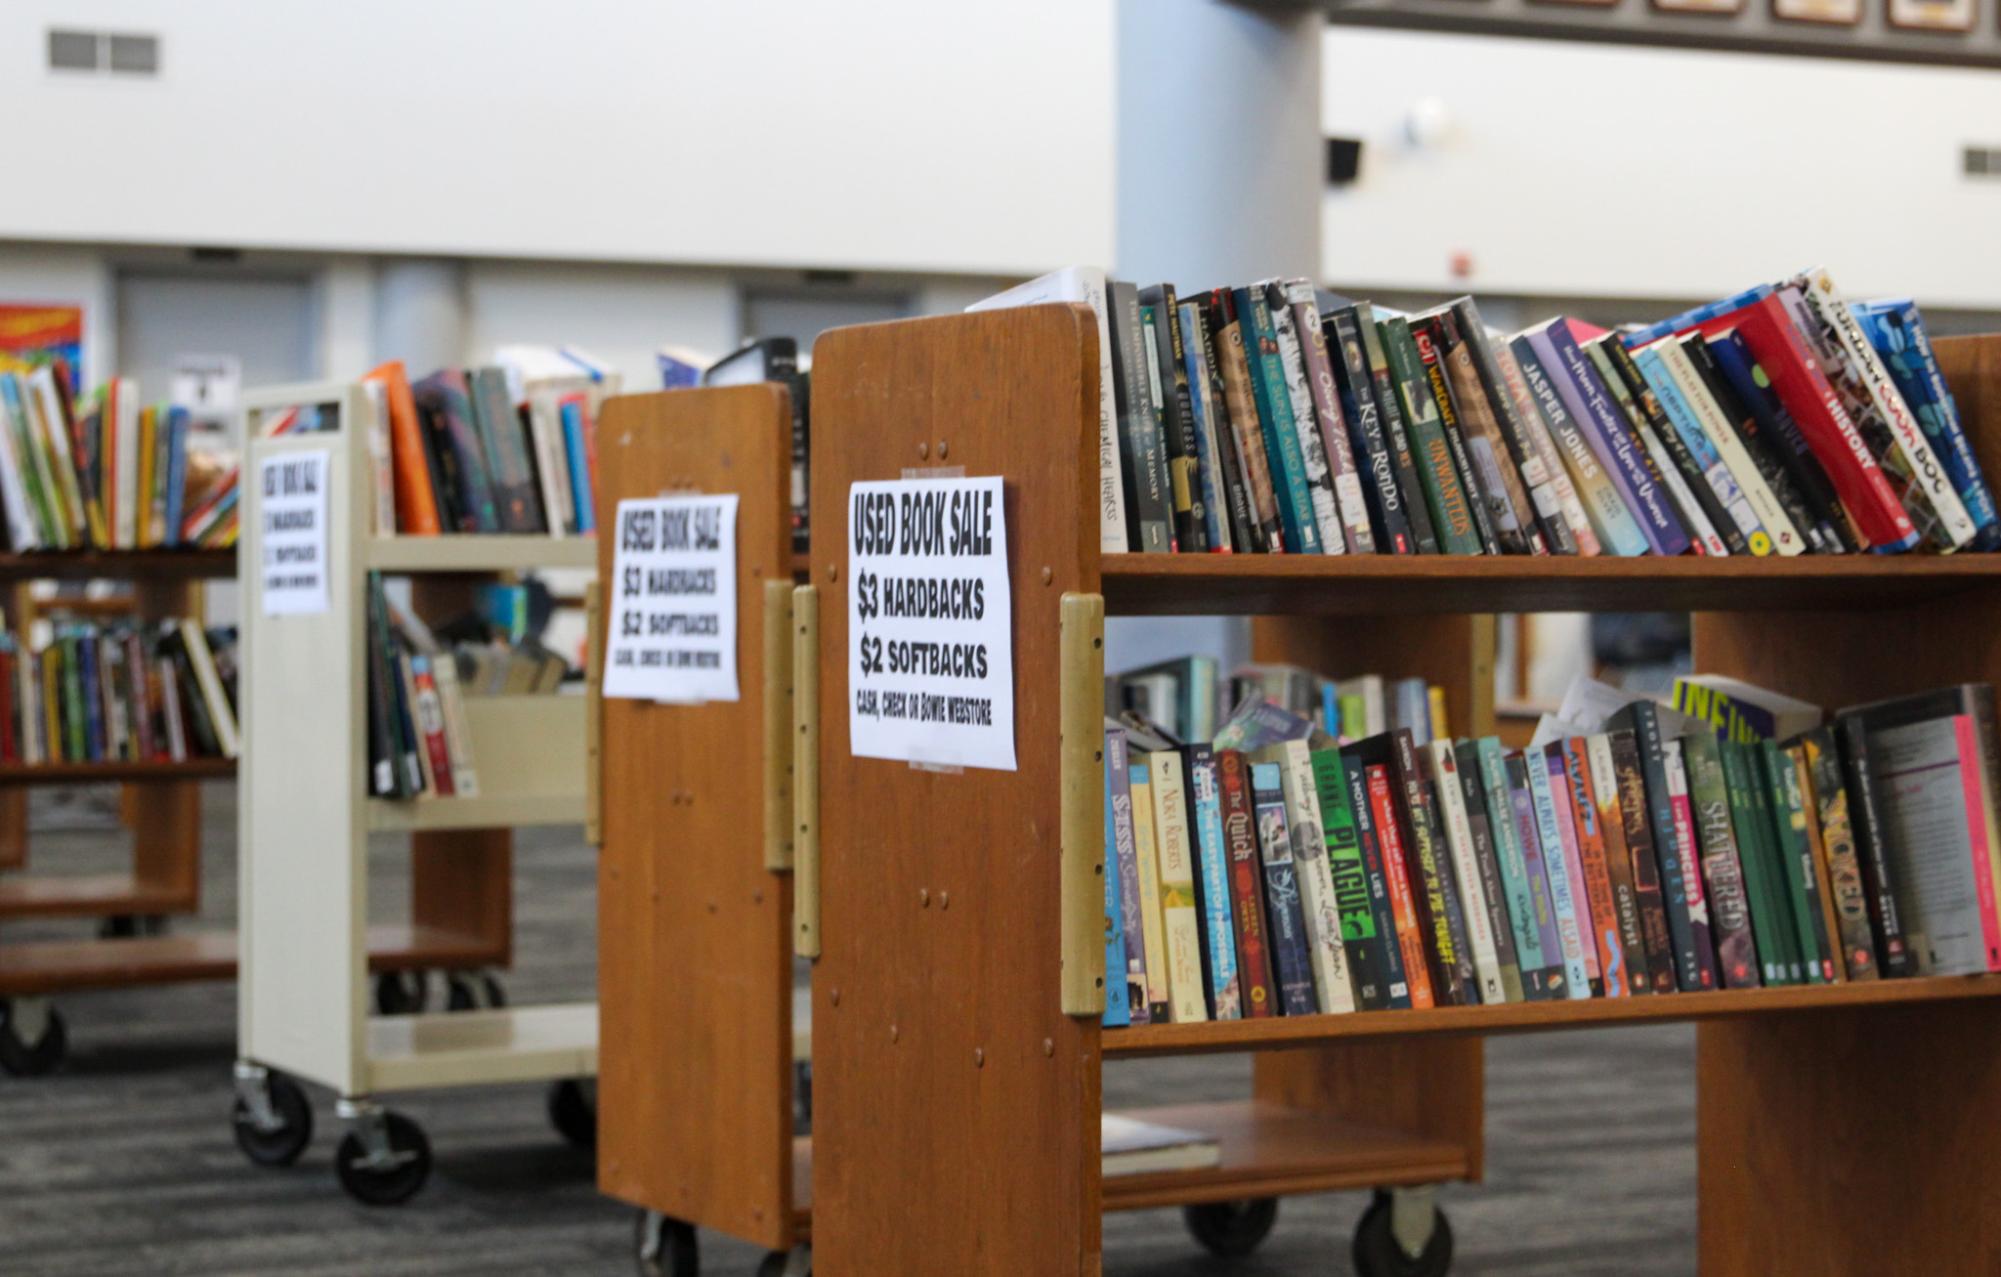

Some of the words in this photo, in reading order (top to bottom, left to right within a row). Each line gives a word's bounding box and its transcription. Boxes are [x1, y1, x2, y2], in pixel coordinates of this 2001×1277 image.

[1265, 357, 1280, 383] THE
[1271, 383, 1288, 416] SUN
[1425, 364, 1459, 427] WARCRAFT
[1279, 418, 1292, 433] IS
[1355, 400, 1386, 443] KEY
[1521, 357, 1567, 428] JASPER
[1558, 421, 1599, 483] JONES
[1823, 397, 1877, 472] HISTORY
[1282, 433, 1301, 472] ALSO
[1291, 473, 1304, 486] A
[855, 492, 896, 556] USED
[900, 490, 946, 556] BOOK
[950, 490, 993, 556] SALE
[1294, 489, 1312, 521] STAR
[858, 568, 878, 624] $3
[884, 577, 984, 621] HARDBACKS
[860, 631, 883, 678] $2
[889, 640, 988, 680] SOFTBACKS
[857, 689, 879, 721] CASH,
[882, 692, 907, 719] CHECK
[909, 694, 919, 720] OR
[921, 691, 945, 724] BOWIE
[947, 697, 992, 726] WEBSTORE
[1349, 770, 1358, 780] A
[1528, 751, 1547, 788] NEVER
[1568, 749, 1592, 823] ALVAREZ
[1162, 788, 1181, 820] NORA
[1352, 781, 1369, 831] MOTHER
[1486, 750, 1503, 787] LAURIE
[1501, 820, 1521, 879] ANDERSON
[1537, 793, 1558, 840] ALWAYS
[1165, 823, 1185, 870] ROBERTS
[1224, 810, 1254, 862] Quick
[1361, 831, 1378, 871] NEVER
[1476, 833, 1487, 851] The
[1519, 814, 1538, 862] HOWE
[1324, 824, 1370, 921] PLAGUE
[1480, 852, 1492, 878] Truth
[1546, 844, 1571, 912] SOMETIMES
[1675, 820, 1699, 902] PRINCESS
[1700, 799, 1745, 932] SHATTERED
[1370, 872, 1384, 899] LIES
[1485, 878, 1498, 905] About
[1617, 884, 1639, 947] catalyst
[1213, 911, 1231, 979] IMPOSSIBLE
[1431, 914, 1456, 967] TONIGHT
